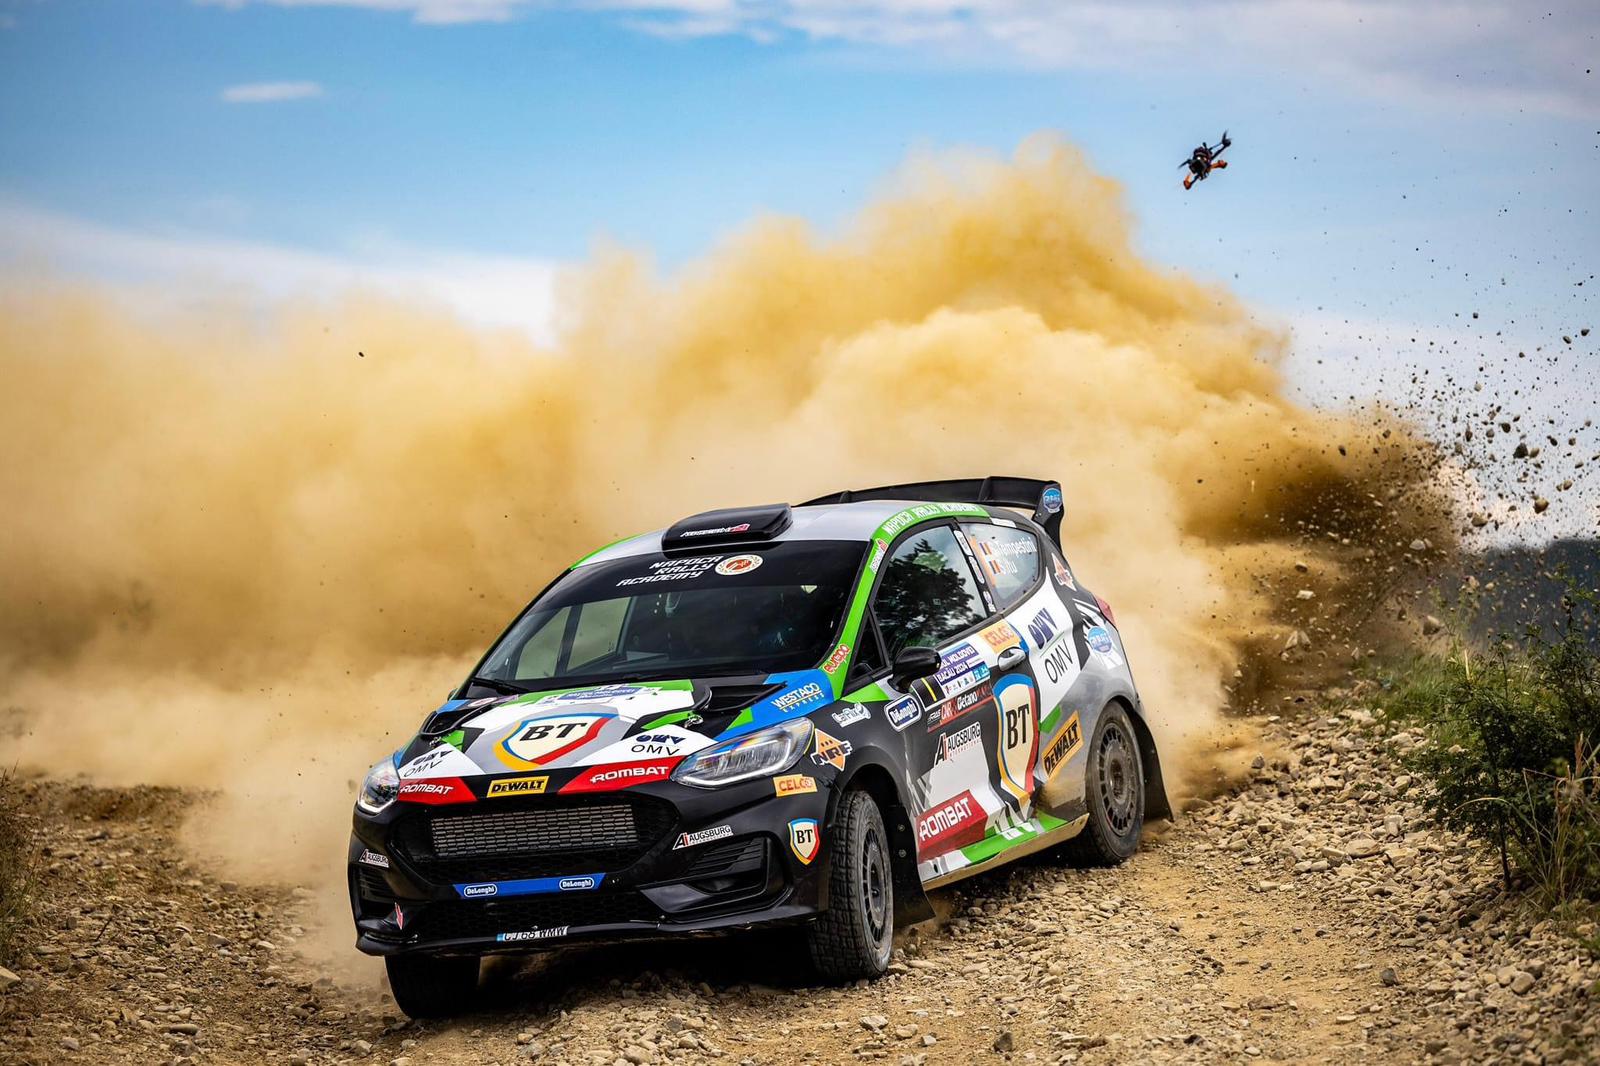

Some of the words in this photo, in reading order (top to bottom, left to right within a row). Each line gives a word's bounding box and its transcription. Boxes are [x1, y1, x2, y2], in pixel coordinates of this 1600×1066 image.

[650, 556, 724, 570] NAPOCA
[655, 563, 714, 576] RALLY
[616, 571, 704, 587] ACADEMY
[1044, 638, 1073, 684] OMV
[773, 682, 820, 709] WESTACO
[783, 693, 824, 713] EXPRESS
[889, 699, 918, 724] DeLonghi
[519, 722, 588, 742] BT
[1006, 703, 1030, 749] BT
[948, 722, 981, 751] AUGSBURG
[631, 744, 680, 756] OMV
[813, 742, 852, 765] NRF
[403, 760, 443, 778] OMV
[590, 766, 669, 783] ROMBAT
[401, 783, 453, 796] ROMBAT
[919, 797, 973, 841] ROMBAT
[689, 825, 731, 842] AUGSBURG
[795, 829, 813, 844] BT
[466, 886, 496, 895] DeLonghi
[562, 879, 592, 889] DeLonghi
